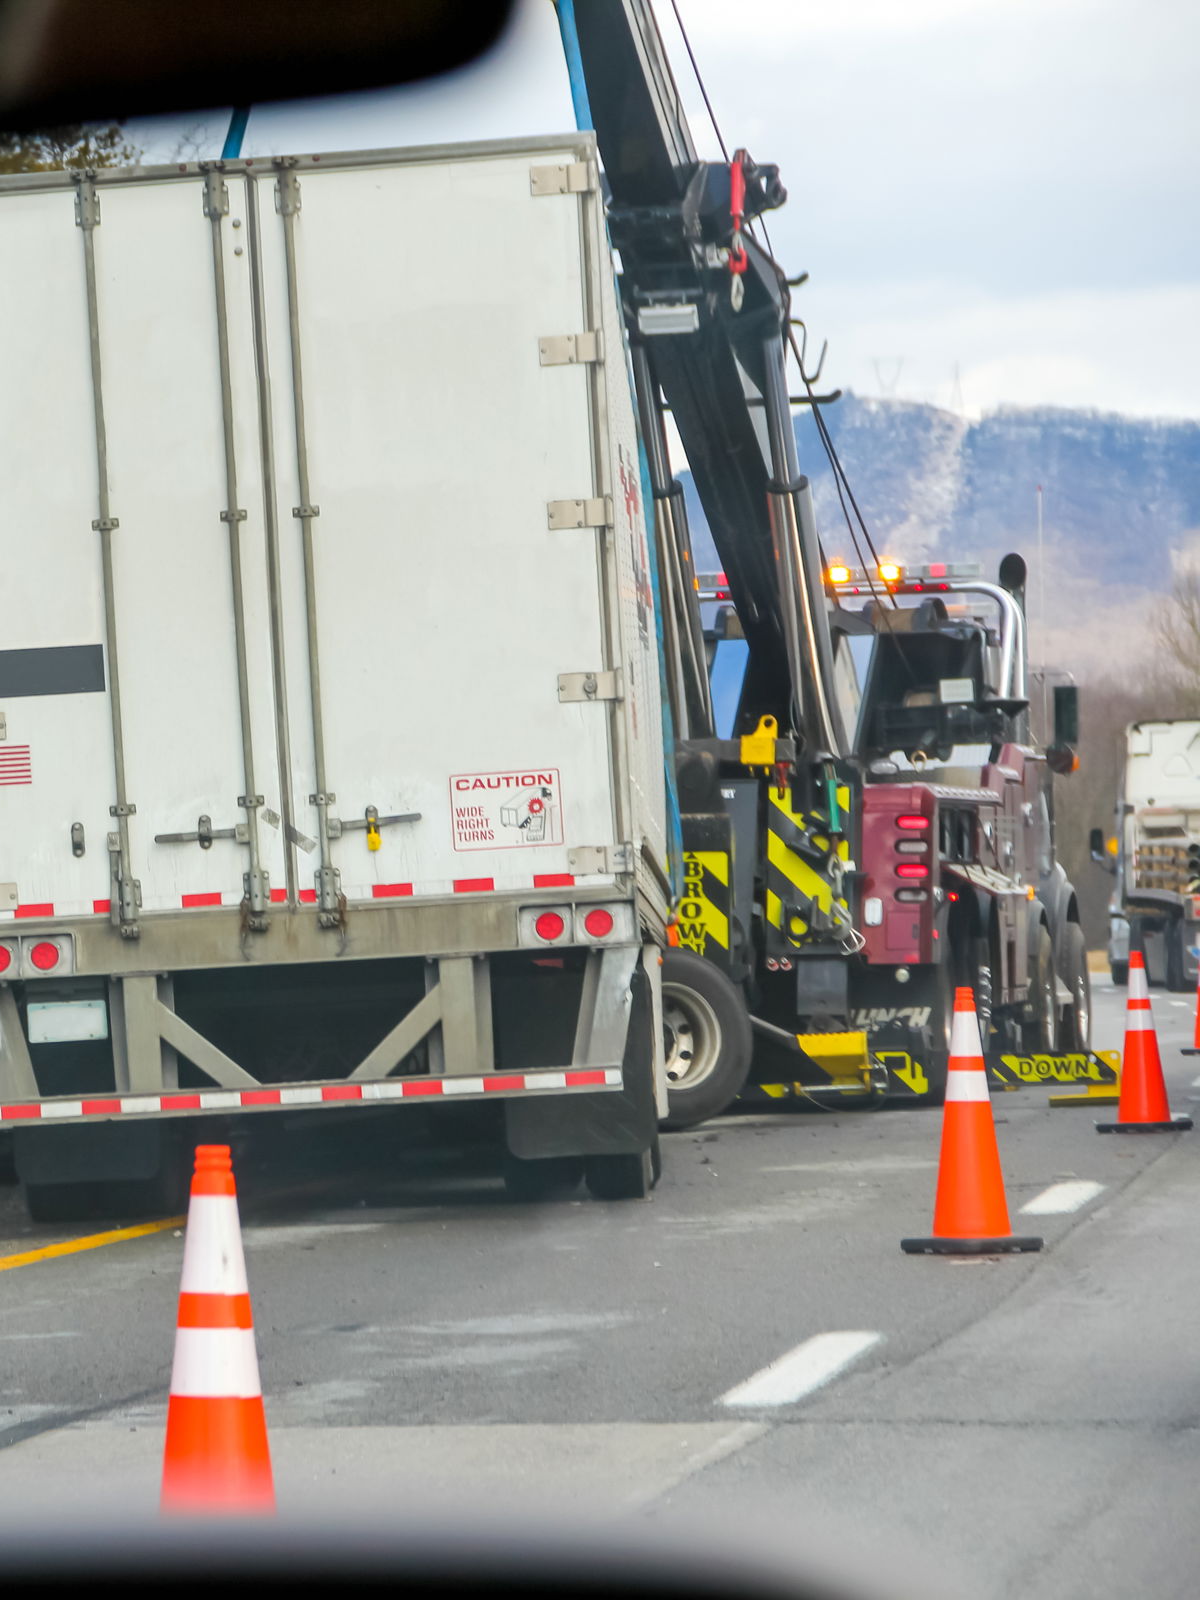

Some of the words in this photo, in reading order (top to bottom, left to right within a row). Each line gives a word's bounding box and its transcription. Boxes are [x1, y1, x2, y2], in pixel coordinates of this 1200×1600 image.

[455, 773, 553, 791] CAUTION
[456, 806, 484, 818] WIDE
[457, 818, 491, 830] RIGHT
[457, 830, 495, 842] TURNS
[1019, 1059, 1090, 1077] DOWN
